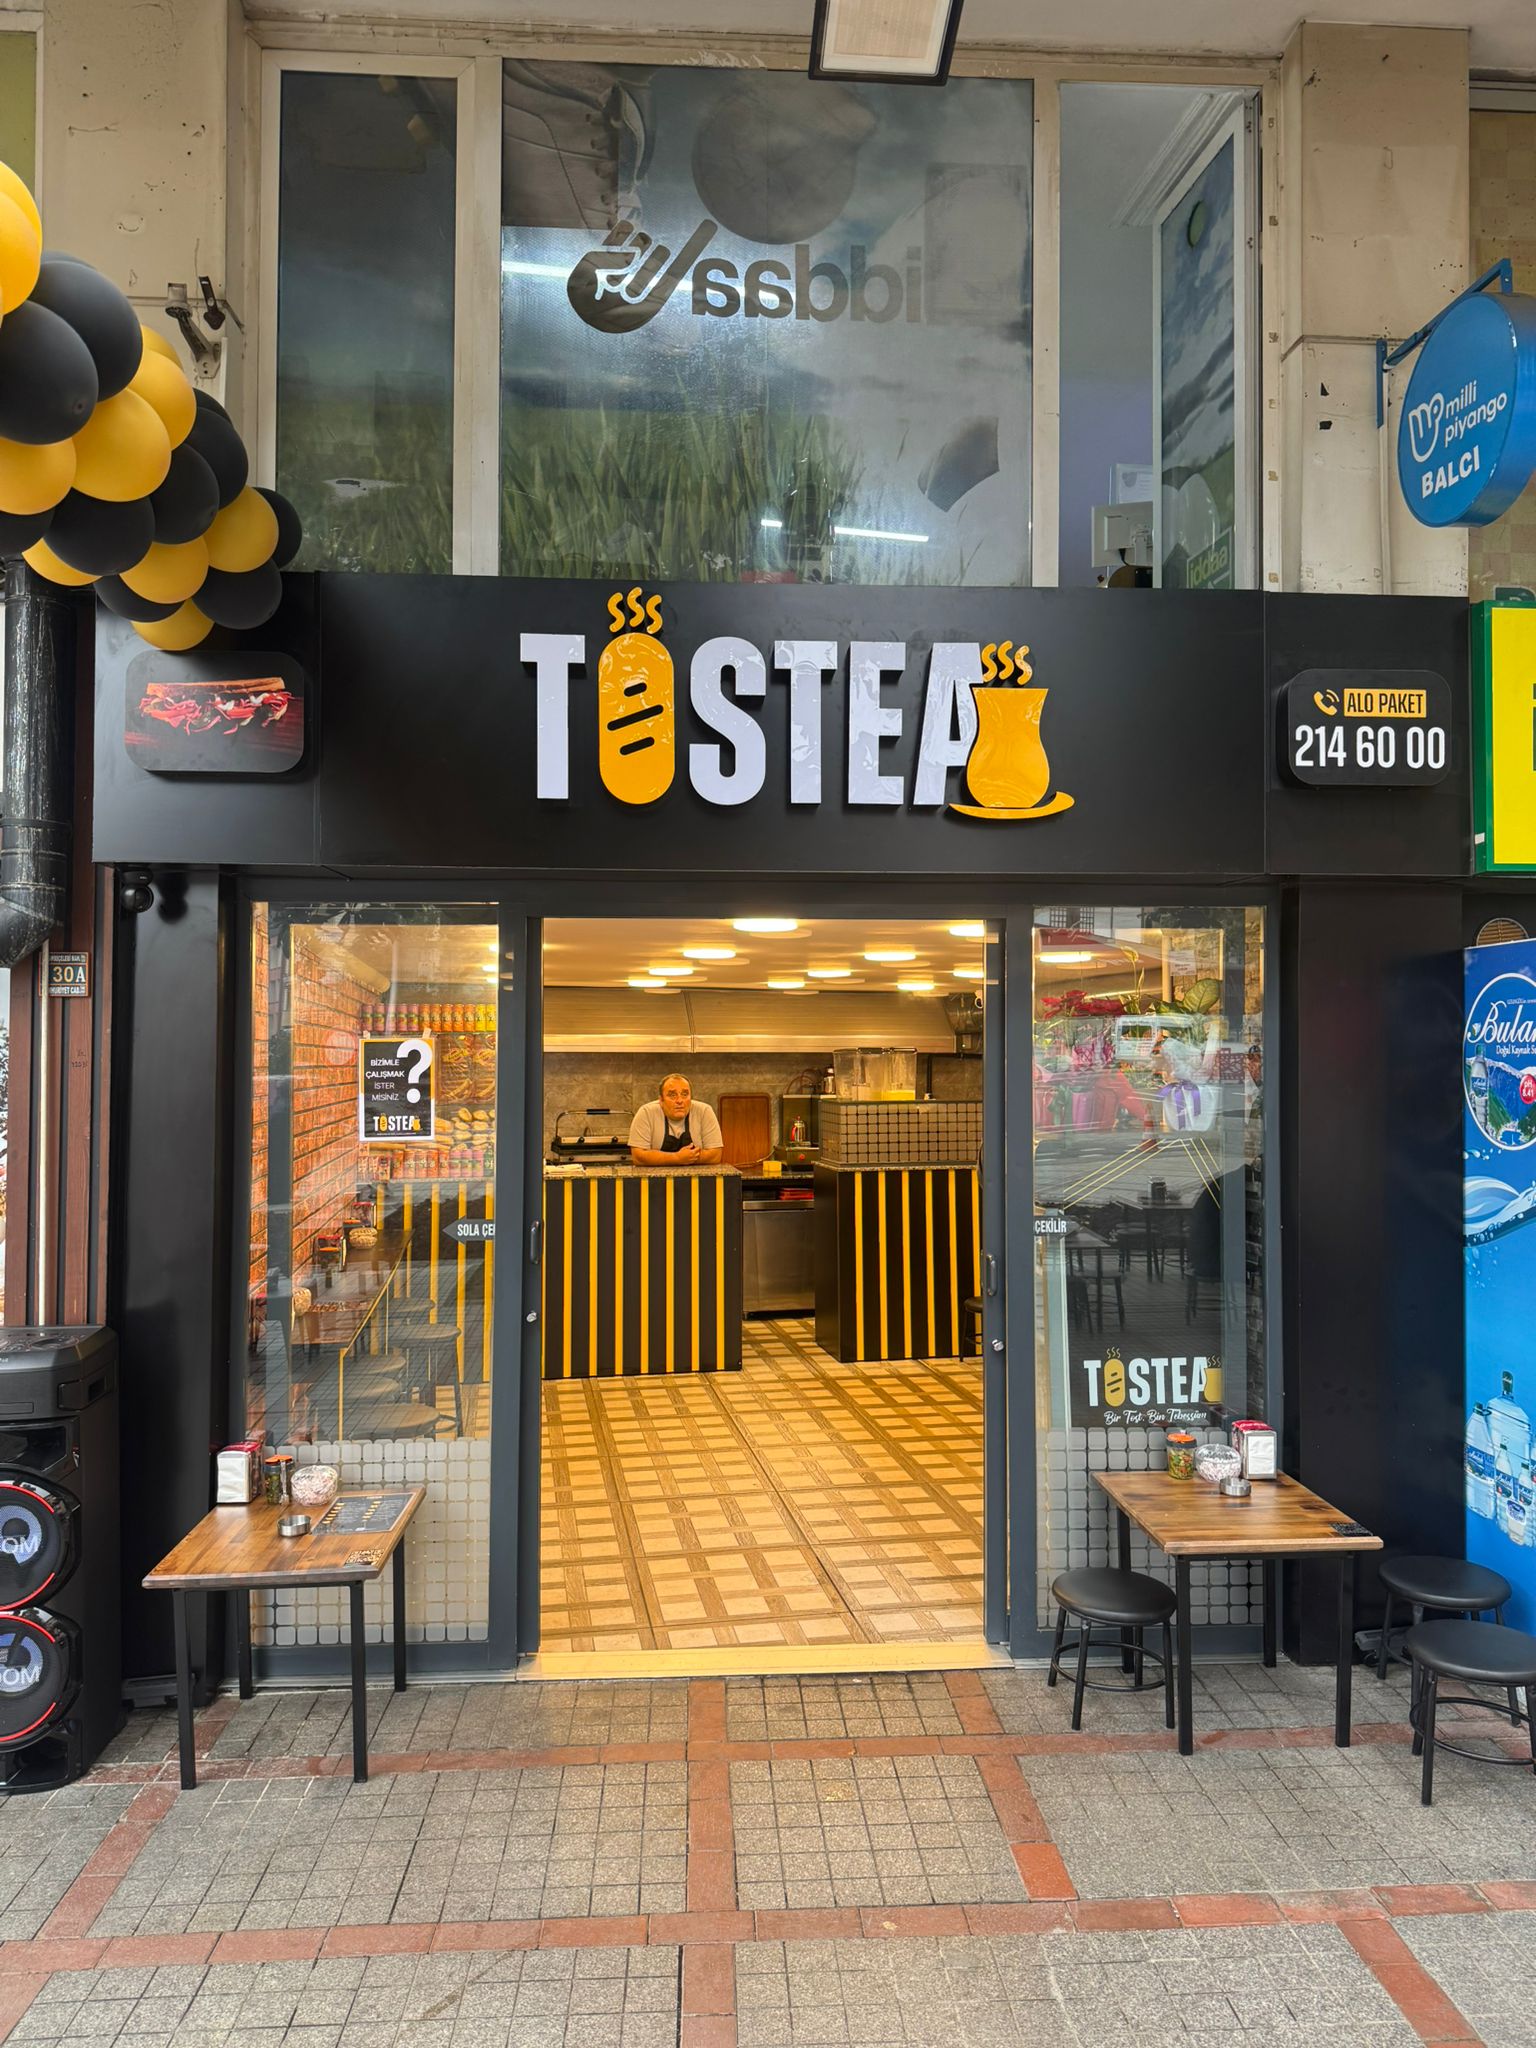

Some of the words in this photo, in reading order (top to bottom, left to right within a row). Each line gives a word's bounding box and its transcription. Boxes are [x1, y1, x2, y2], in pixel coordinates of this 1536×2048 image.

[1445, 379, 1478, 419] milli
[1444, 392, 1508, 448] piyango
[1421, 444, 1480, 499] BALCI
[1347, 692, 1374, 713] ALO
[1378, 693, 1424, 714] PAKET
[1295, 724, 1347, 768] 214
[1356, 725, 1396, 769] 60
[1406, 726, 1446, 770] 00
[370, 1057, 400, 1067] BİZİMLE
[365, 1070, 405, 1080] ÇALIŞMAK
[374, 1081, 395, 1089] İSTER
[371, 1093, 400, 1102] MİSİNİZ
[457, 1223, 480, 1236] SOLA
[1034, 1217, 1067, 1234] ÇEKİLİR
[1104, 1410, 1122, 1425] Bir
[1147, 1410, 1166, 1424] Bin
